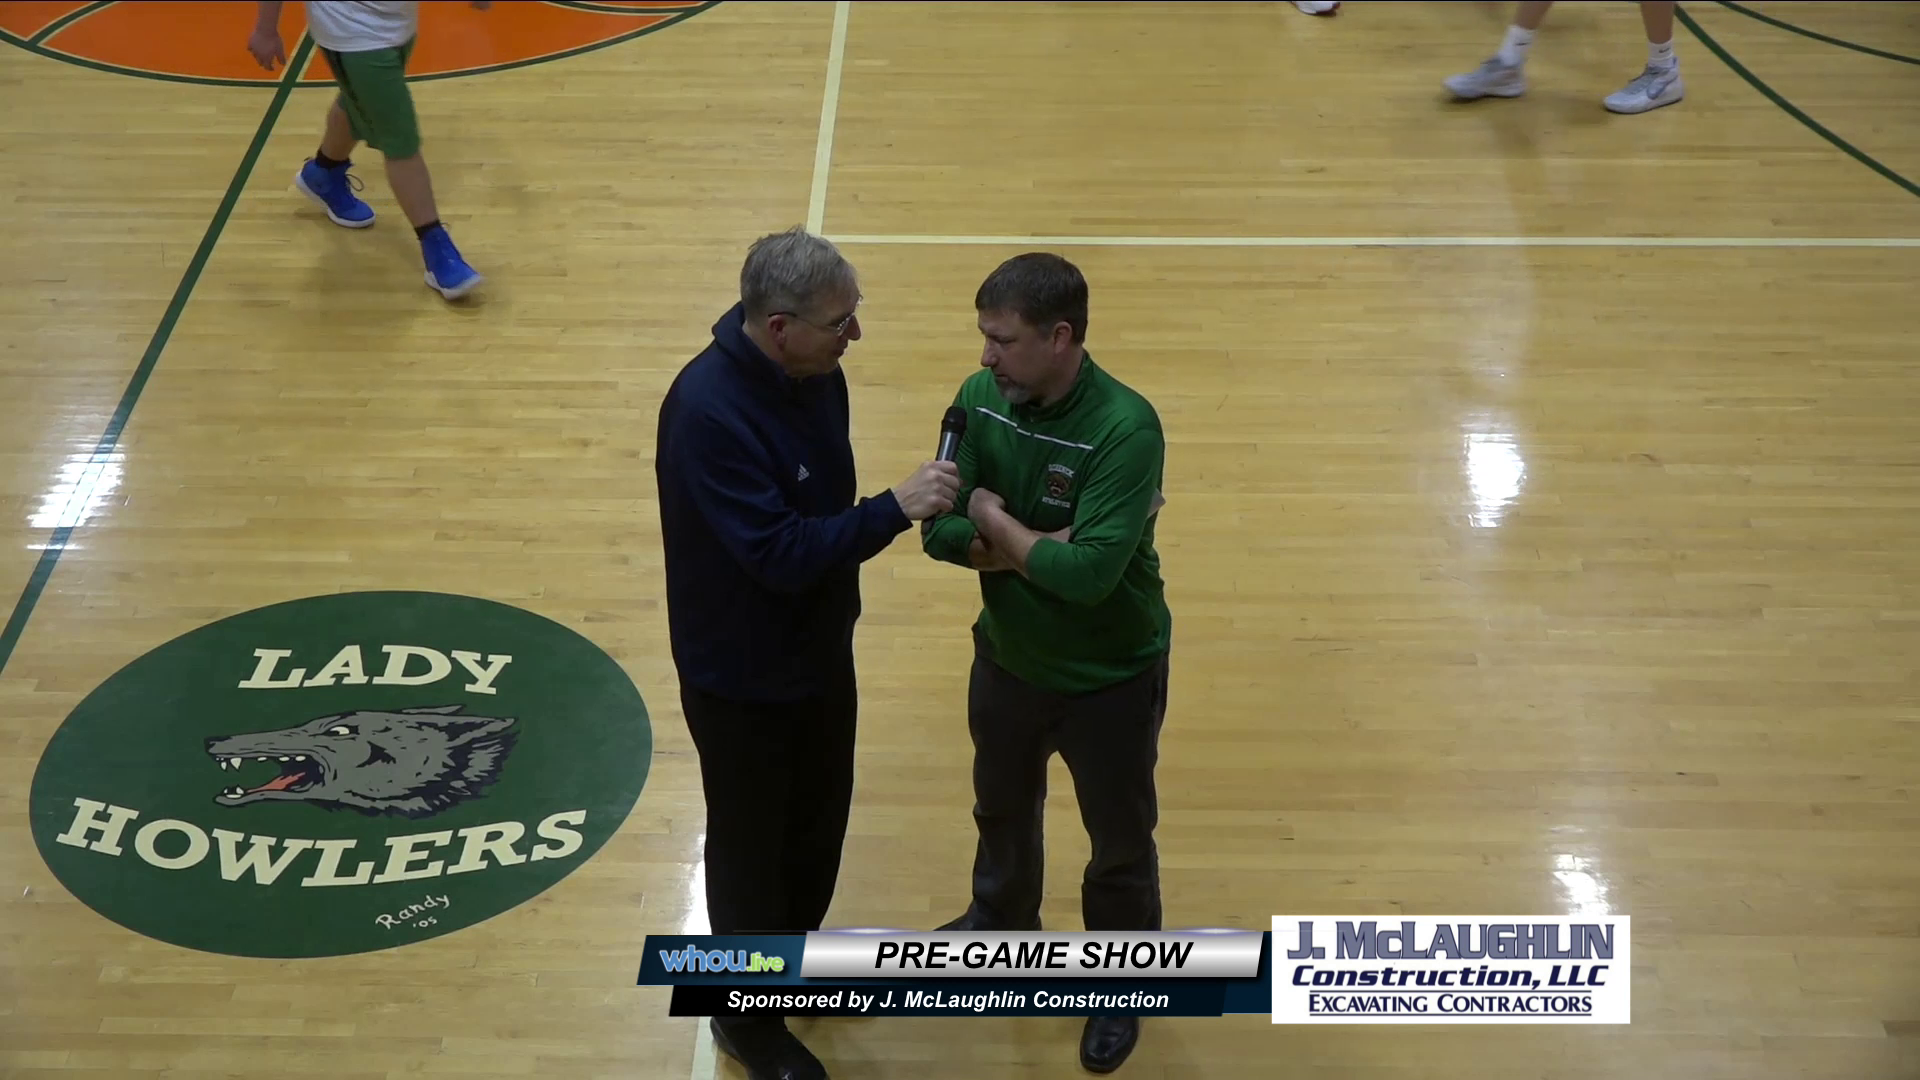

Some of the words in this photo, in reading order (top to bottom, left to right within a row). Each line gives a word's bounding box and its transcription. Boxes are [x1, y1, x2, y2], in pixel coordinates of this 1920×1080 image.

[238, 644, 512, 694] LADY
[56, 797, 588, 887] HOWLERS
[375, 895, 450, 930] Randy
